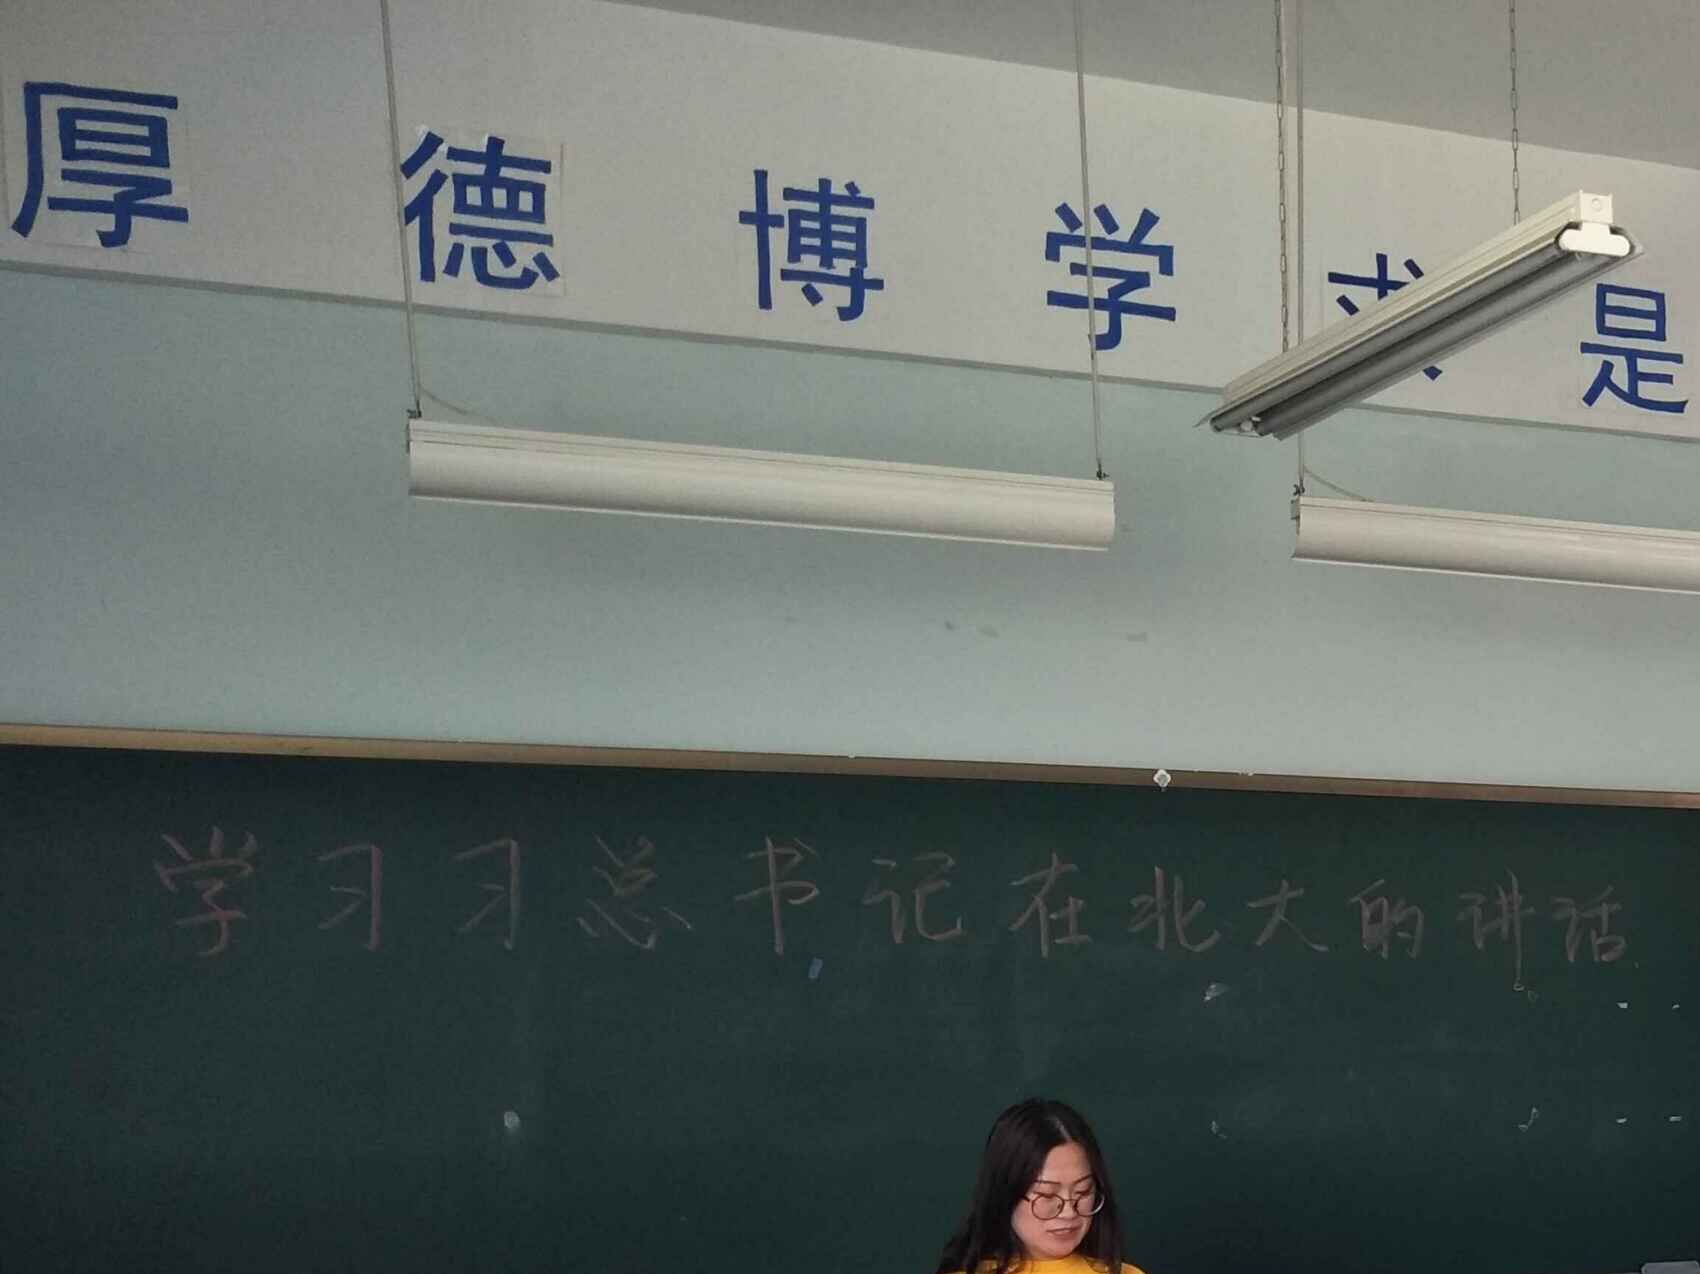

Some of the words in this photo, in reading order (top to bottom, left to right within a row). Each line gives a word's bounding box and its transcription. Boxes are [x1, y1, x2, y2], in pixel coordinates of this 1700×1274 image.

[151, 825, 1627, 985] 学习习总书记在北大的讲话
